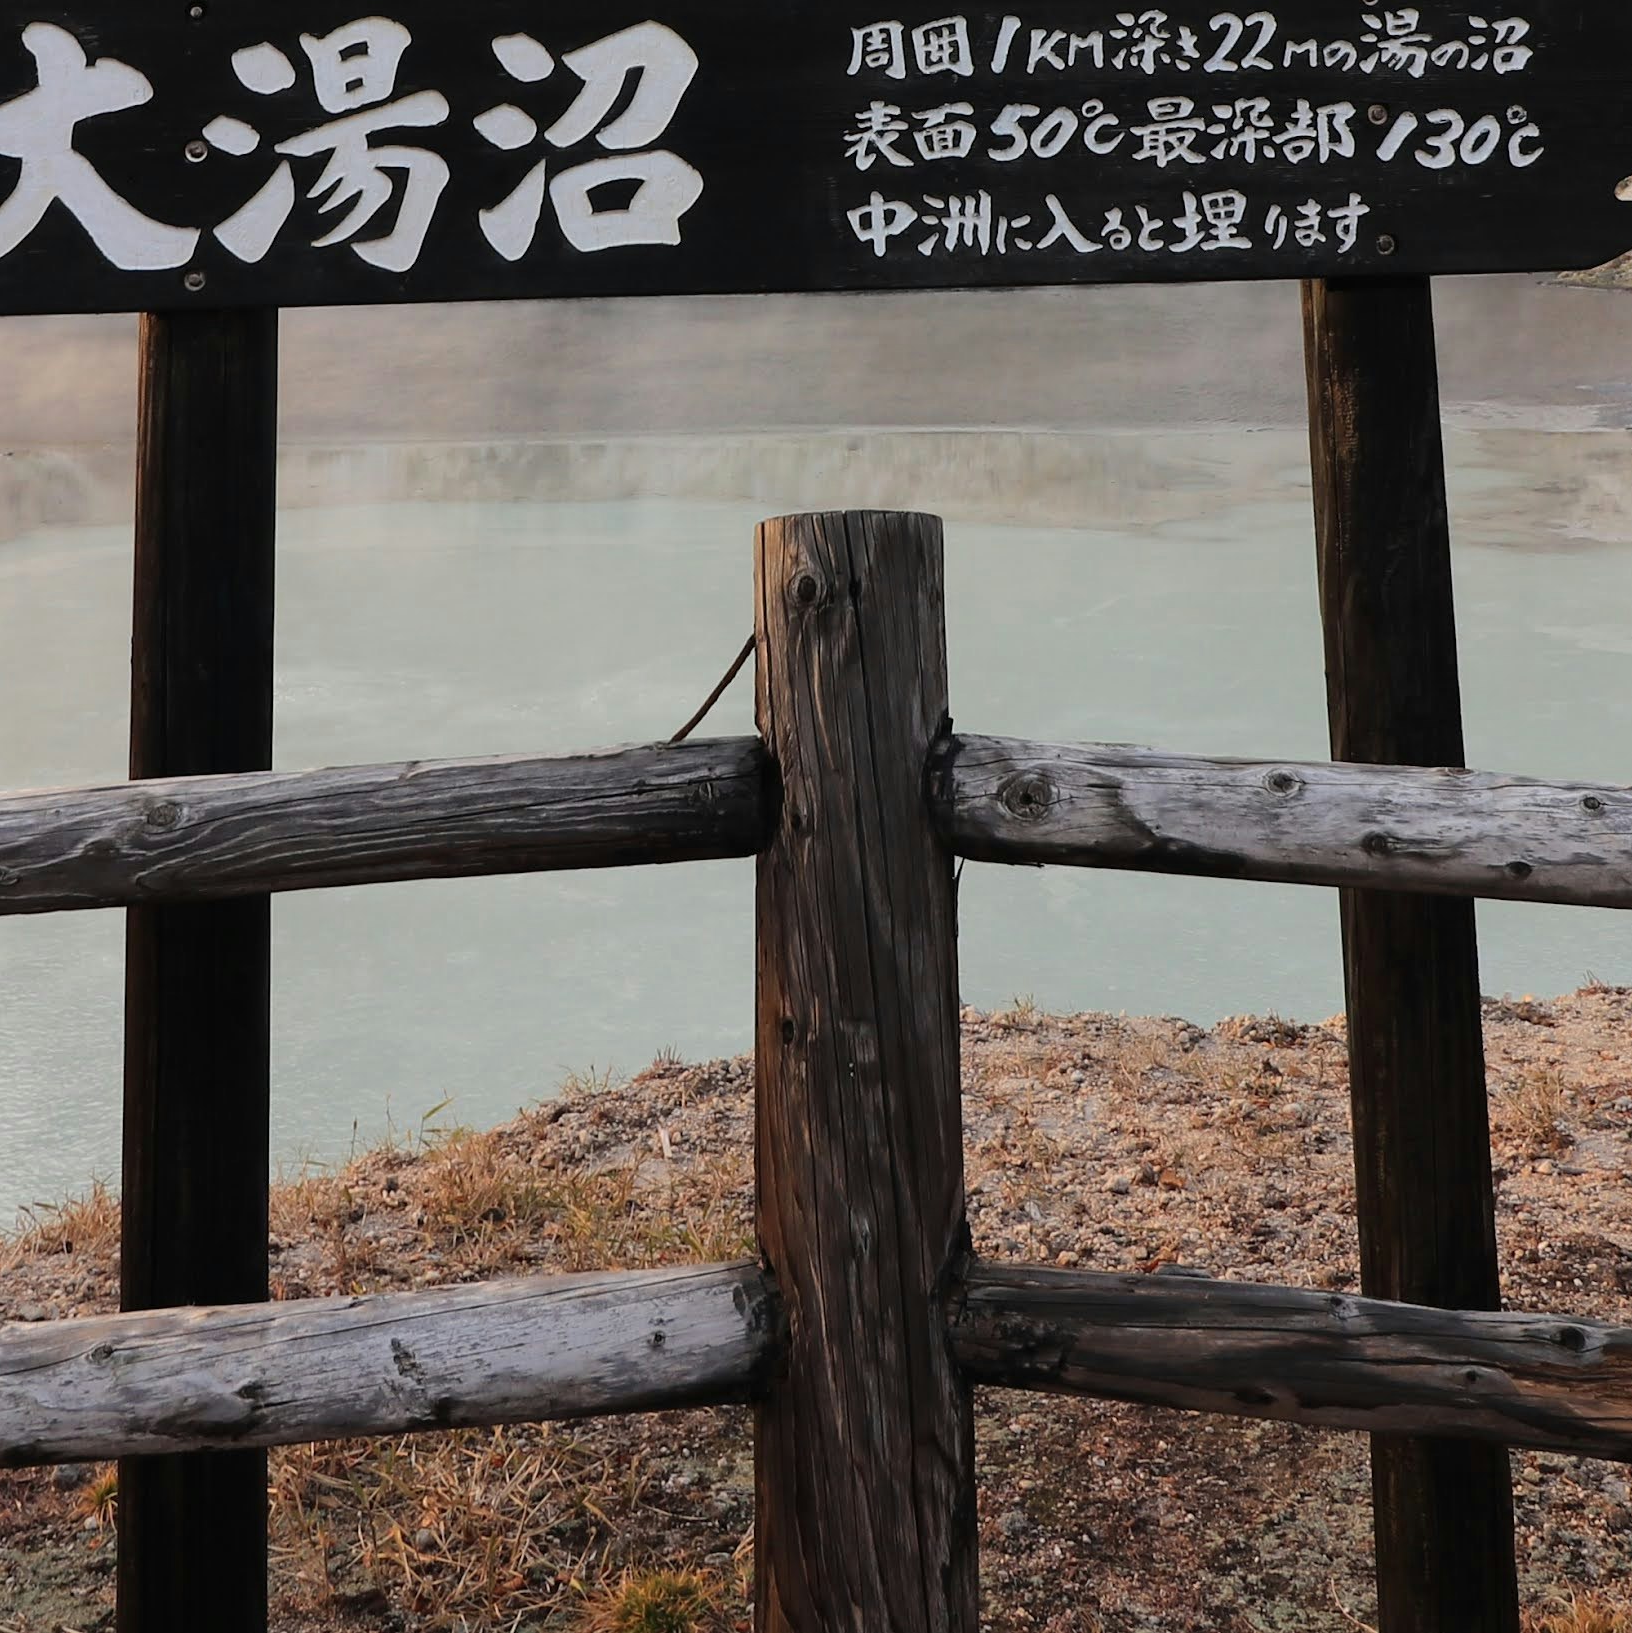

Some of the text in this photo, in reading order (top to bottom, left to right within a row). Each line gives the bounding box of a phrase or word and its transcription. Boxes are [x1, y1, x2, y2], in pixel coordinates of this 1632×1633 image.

[846, 188, 1371, 257] 中洲に入ると埋ります
